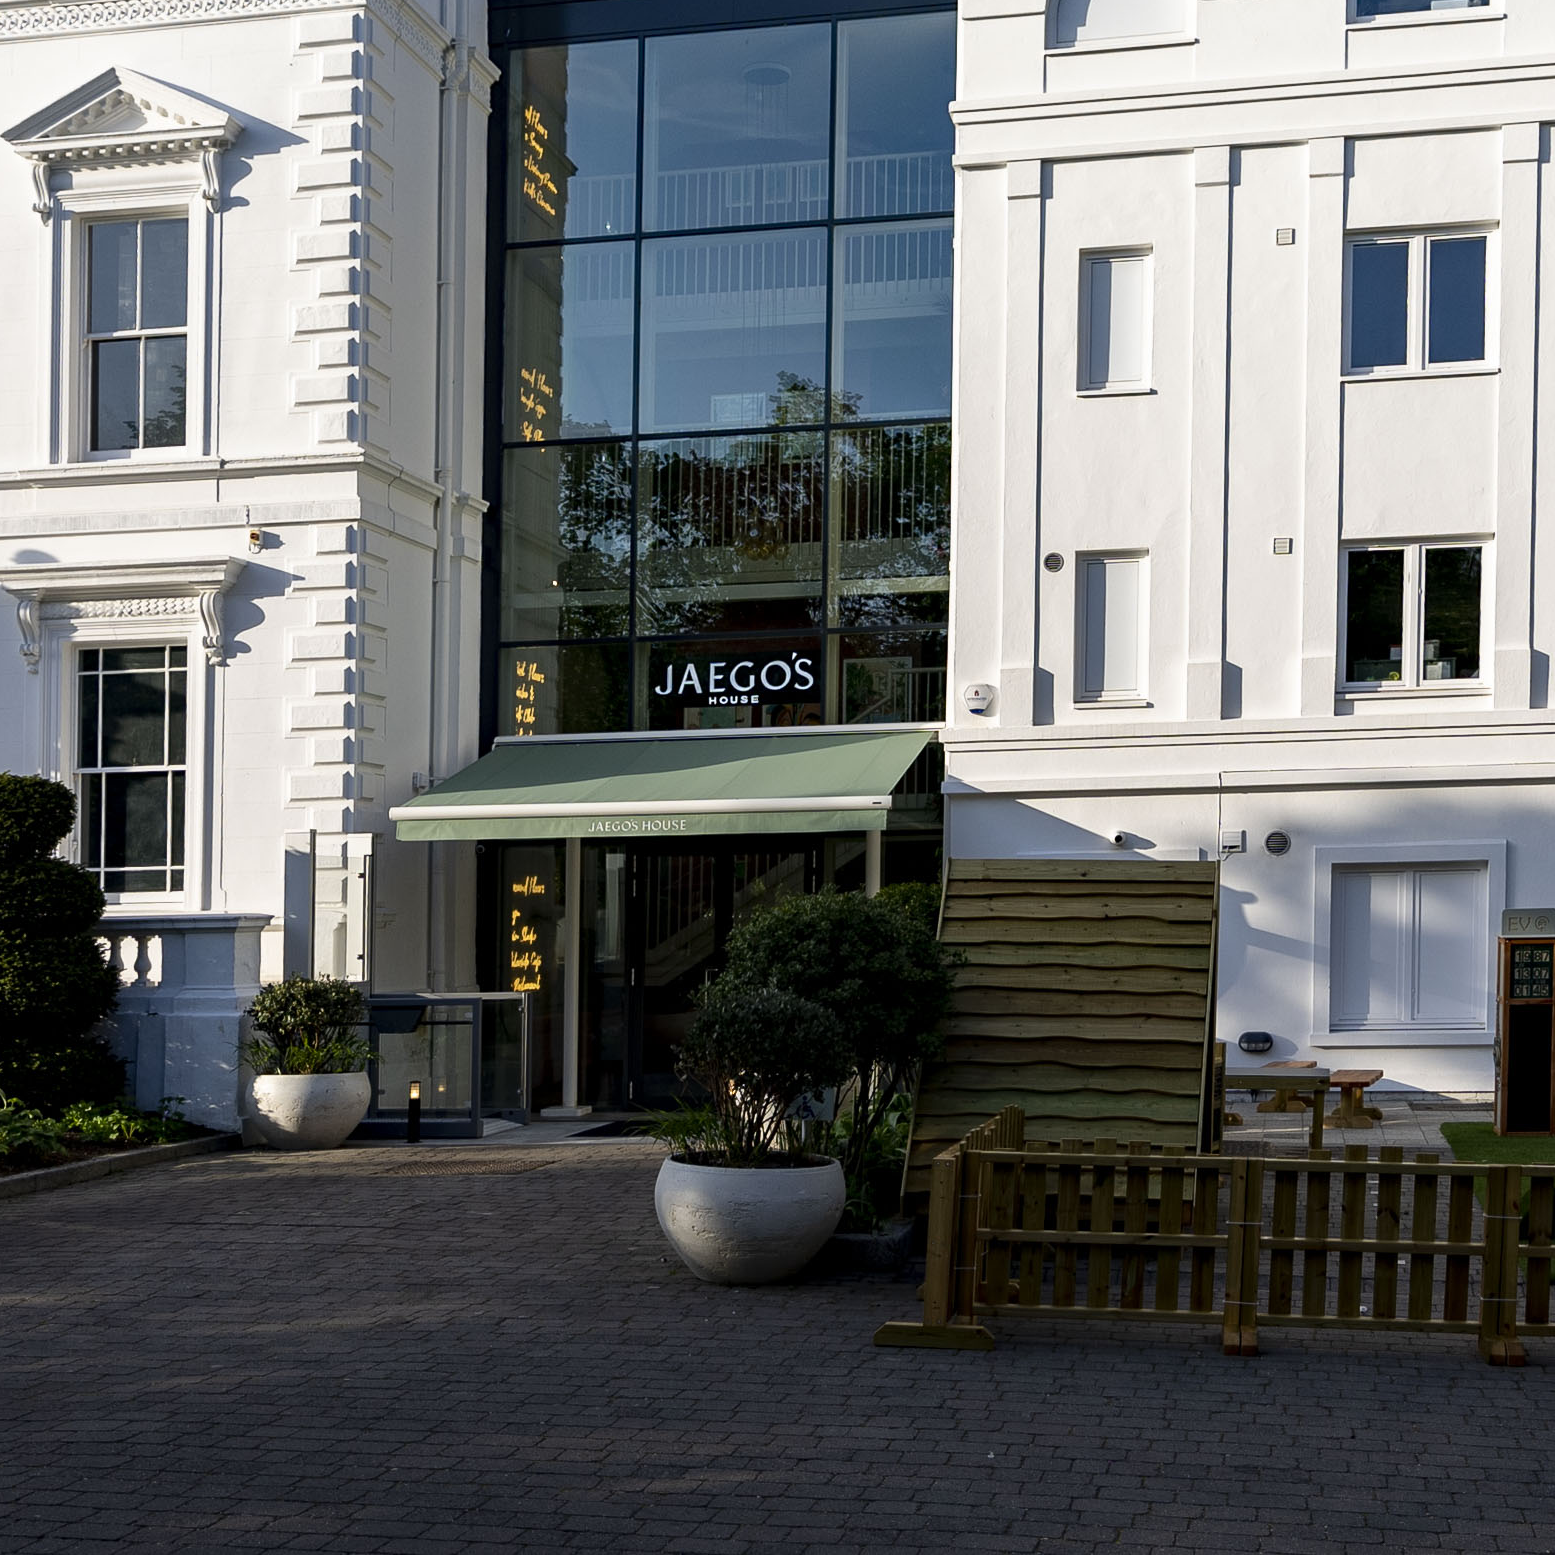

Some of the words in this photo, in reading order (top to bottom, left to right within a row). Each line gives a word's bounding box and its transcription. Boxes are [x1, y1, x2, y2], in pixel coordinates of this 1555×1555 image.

[655, 652, 814, 695] JAEGO'S
[708, 695, 759, 705] HOUSE
[588, 819, 639, 832] JAEGO'S
[642, 819, 687, 831] HOUSE
[1508, 916, 1531, 932] EV
